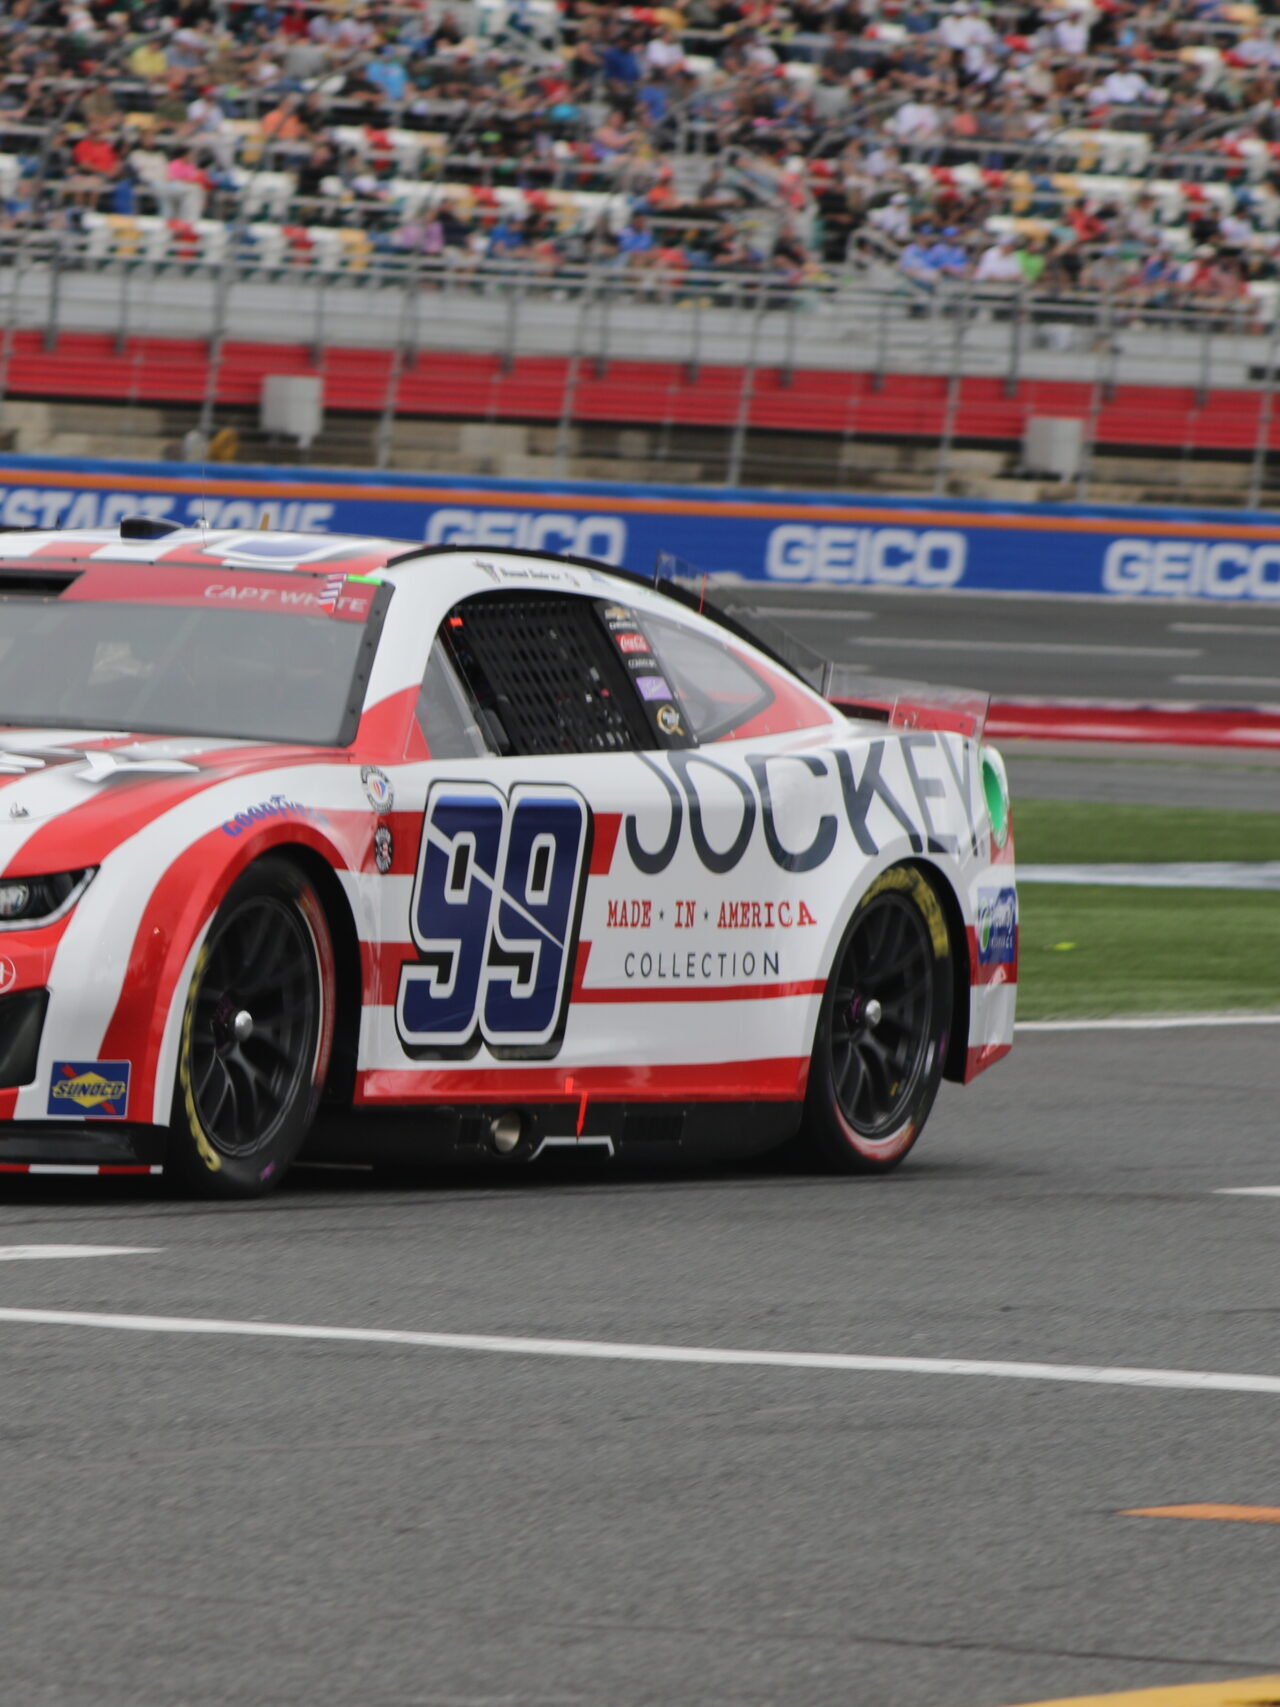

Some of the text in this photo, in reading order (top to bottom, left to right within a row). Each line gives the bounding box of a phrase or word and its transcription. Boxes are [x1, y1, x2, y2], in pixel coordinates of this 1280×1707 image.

[425, 508, 628, 565] GEICO
[765, 523, 968, 587] GEICO
[204, 584, 368, 613] CAPT WHTE
[625, 731, 978, 875] JOCKEY
[394, 777, 594, 1061] 99
[606, 900, 817, 928] MADE IN AMERICA
[624, 951, 780, 978] COLLECTION
[53, 1080, 126, 1098] SUNOCO
